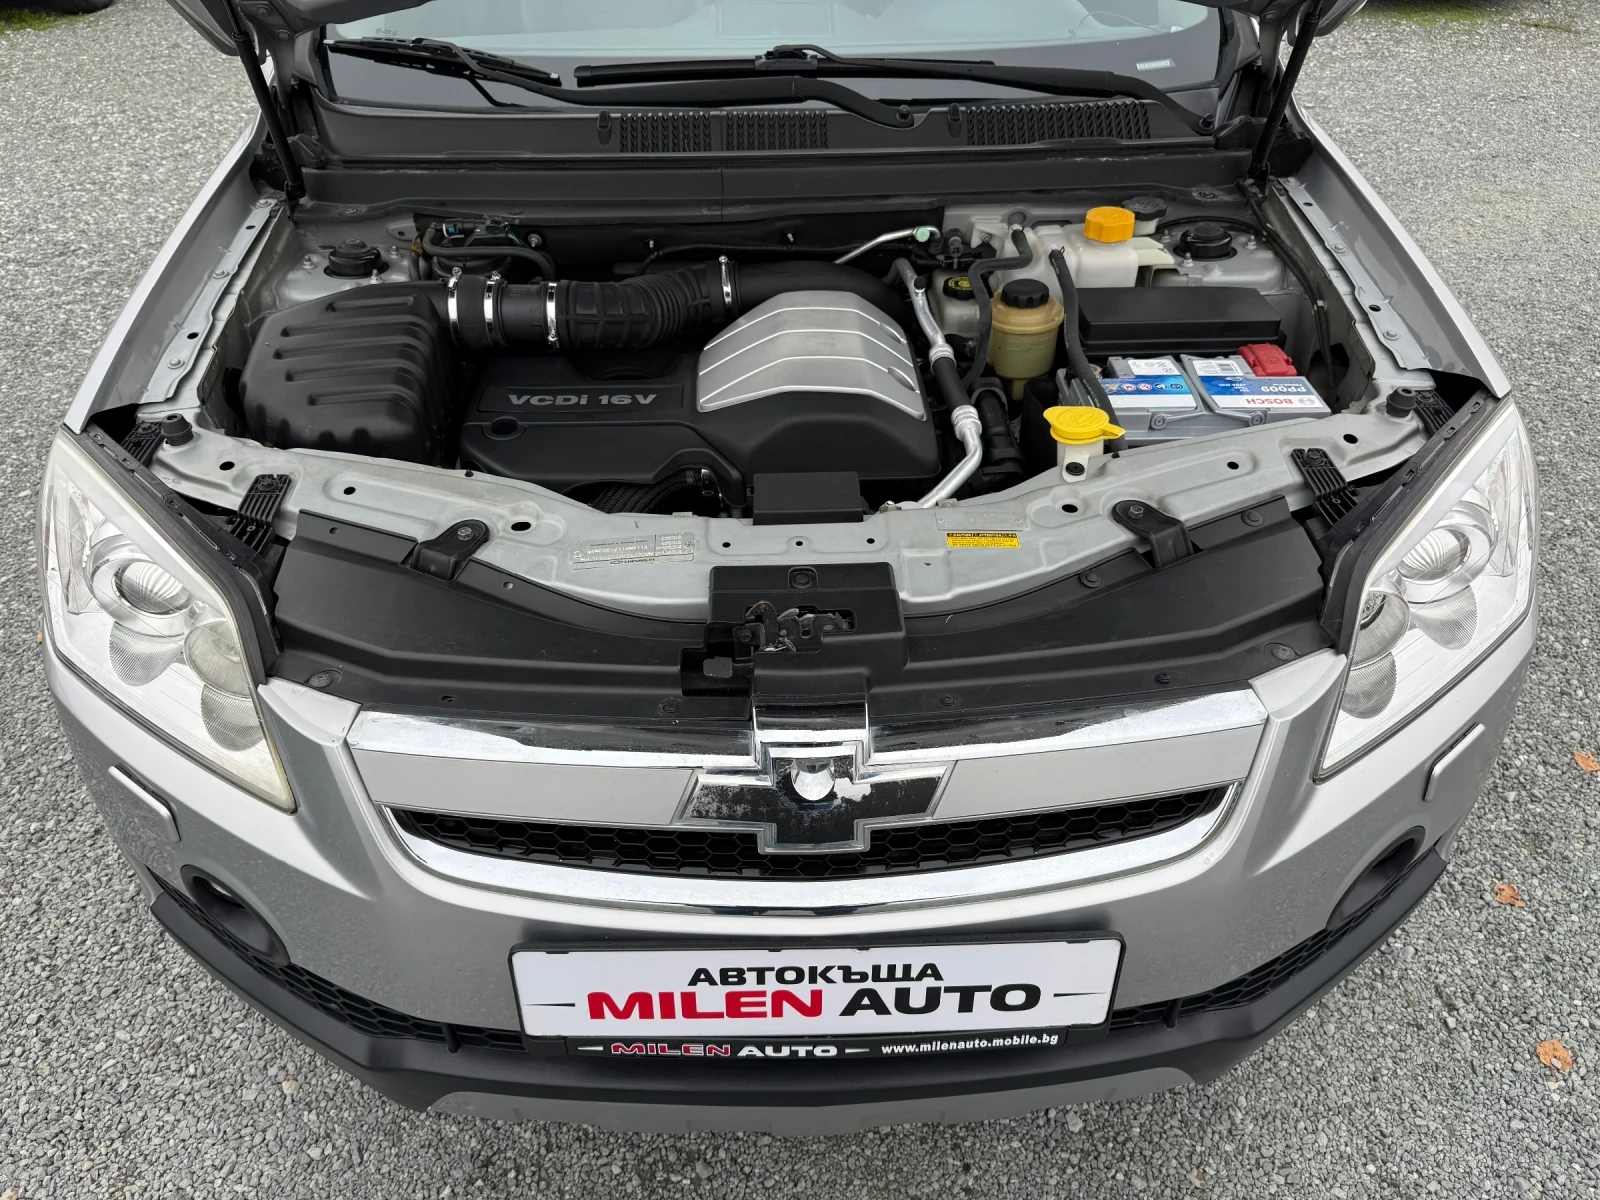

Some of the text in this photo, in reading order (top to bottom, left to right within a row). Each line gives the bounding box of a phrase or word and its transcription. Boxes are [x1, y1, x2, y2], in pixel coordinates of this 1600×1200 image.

[508, 394, 657, 405] VCDi 16V
[587, 983, 1042, 1020] MILEN AUTO
[611, 1033, 1059, 1057] MILEN AUTO www.milenauto.mobile.bg
